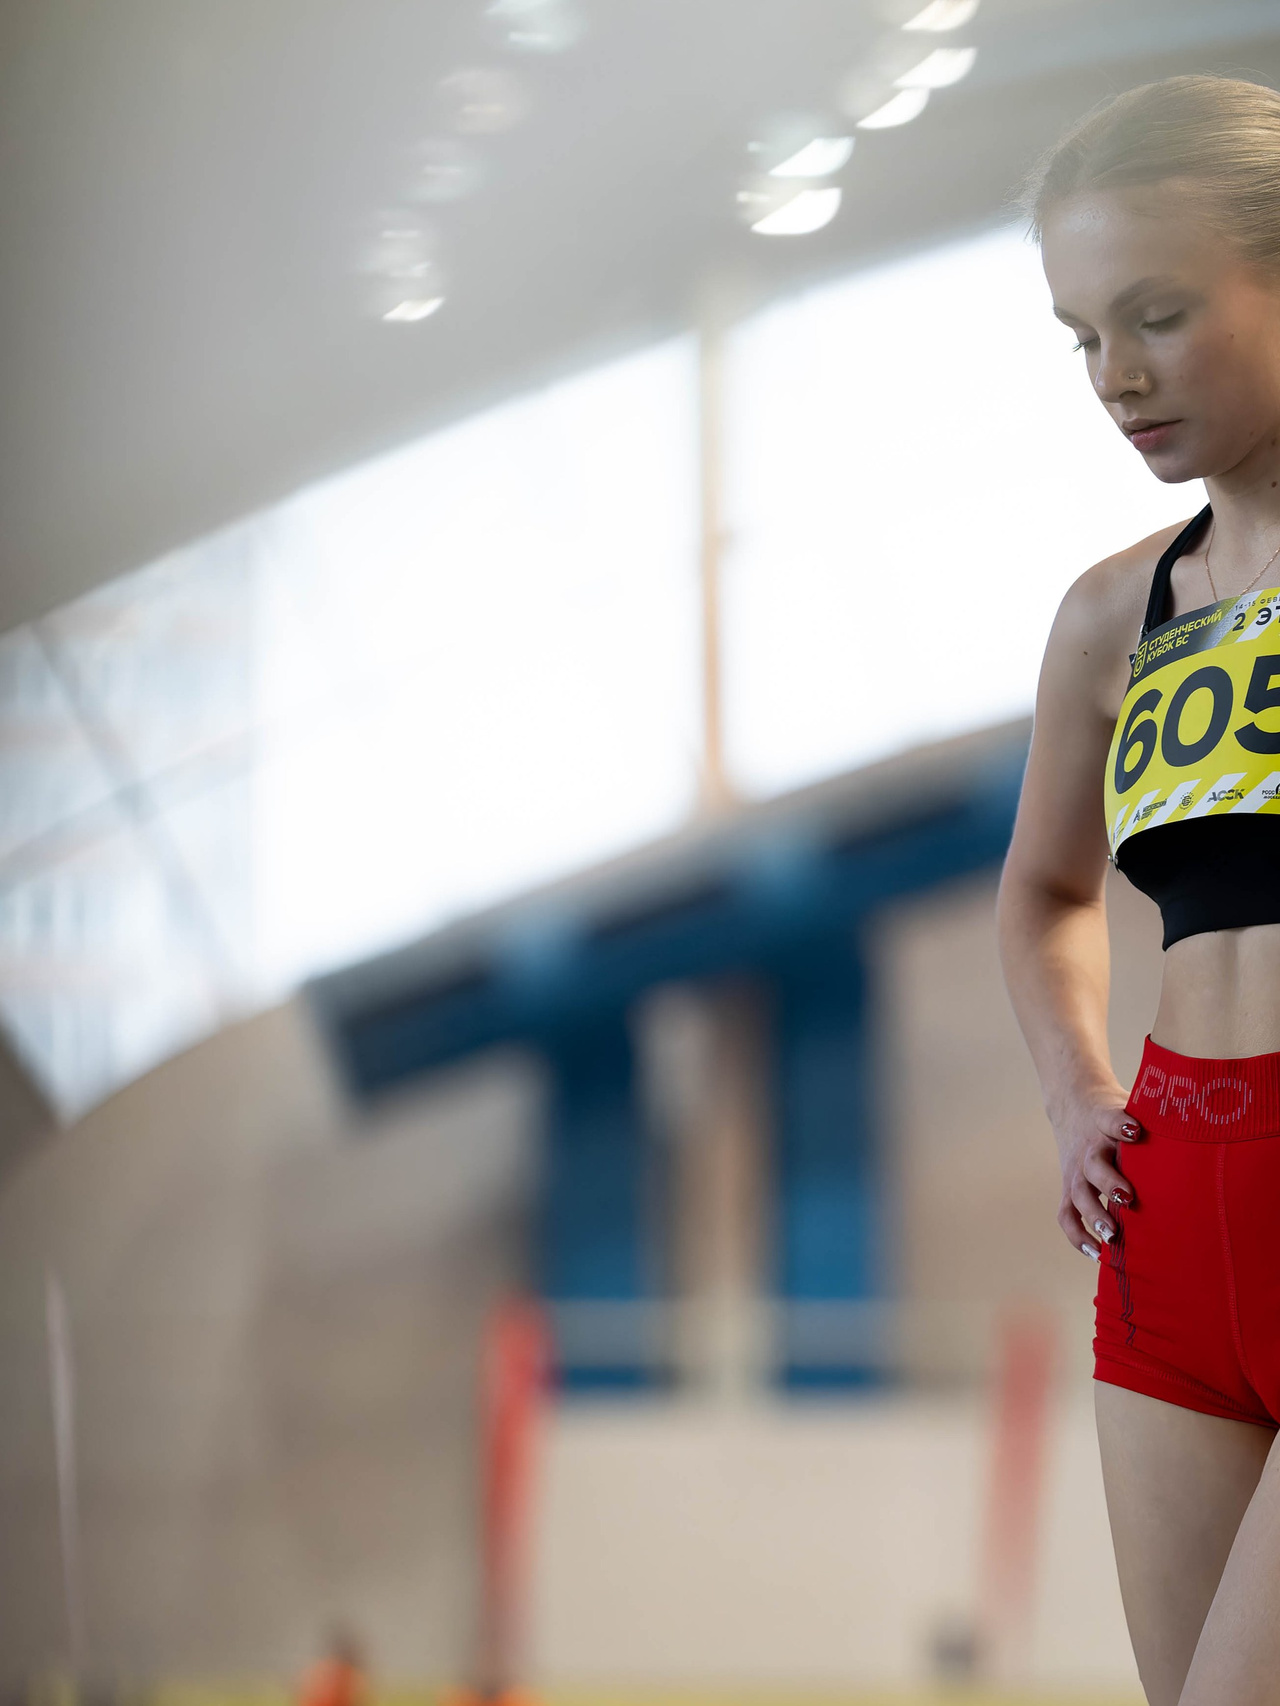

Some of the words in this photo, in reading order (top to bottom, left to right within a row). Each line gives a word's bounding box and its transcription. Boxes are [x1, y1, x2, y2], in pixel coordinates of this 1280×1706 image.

[1148, 609, 1223, 651] СТУДЕНЧЕСКИЙ
[1232, 612, 1246, 632] 2
[1146, 641, 1174, 663] КУБОК
[1175, 634, 1190, 648] БС
[1132, 1063, 1252, 1125] PRO
